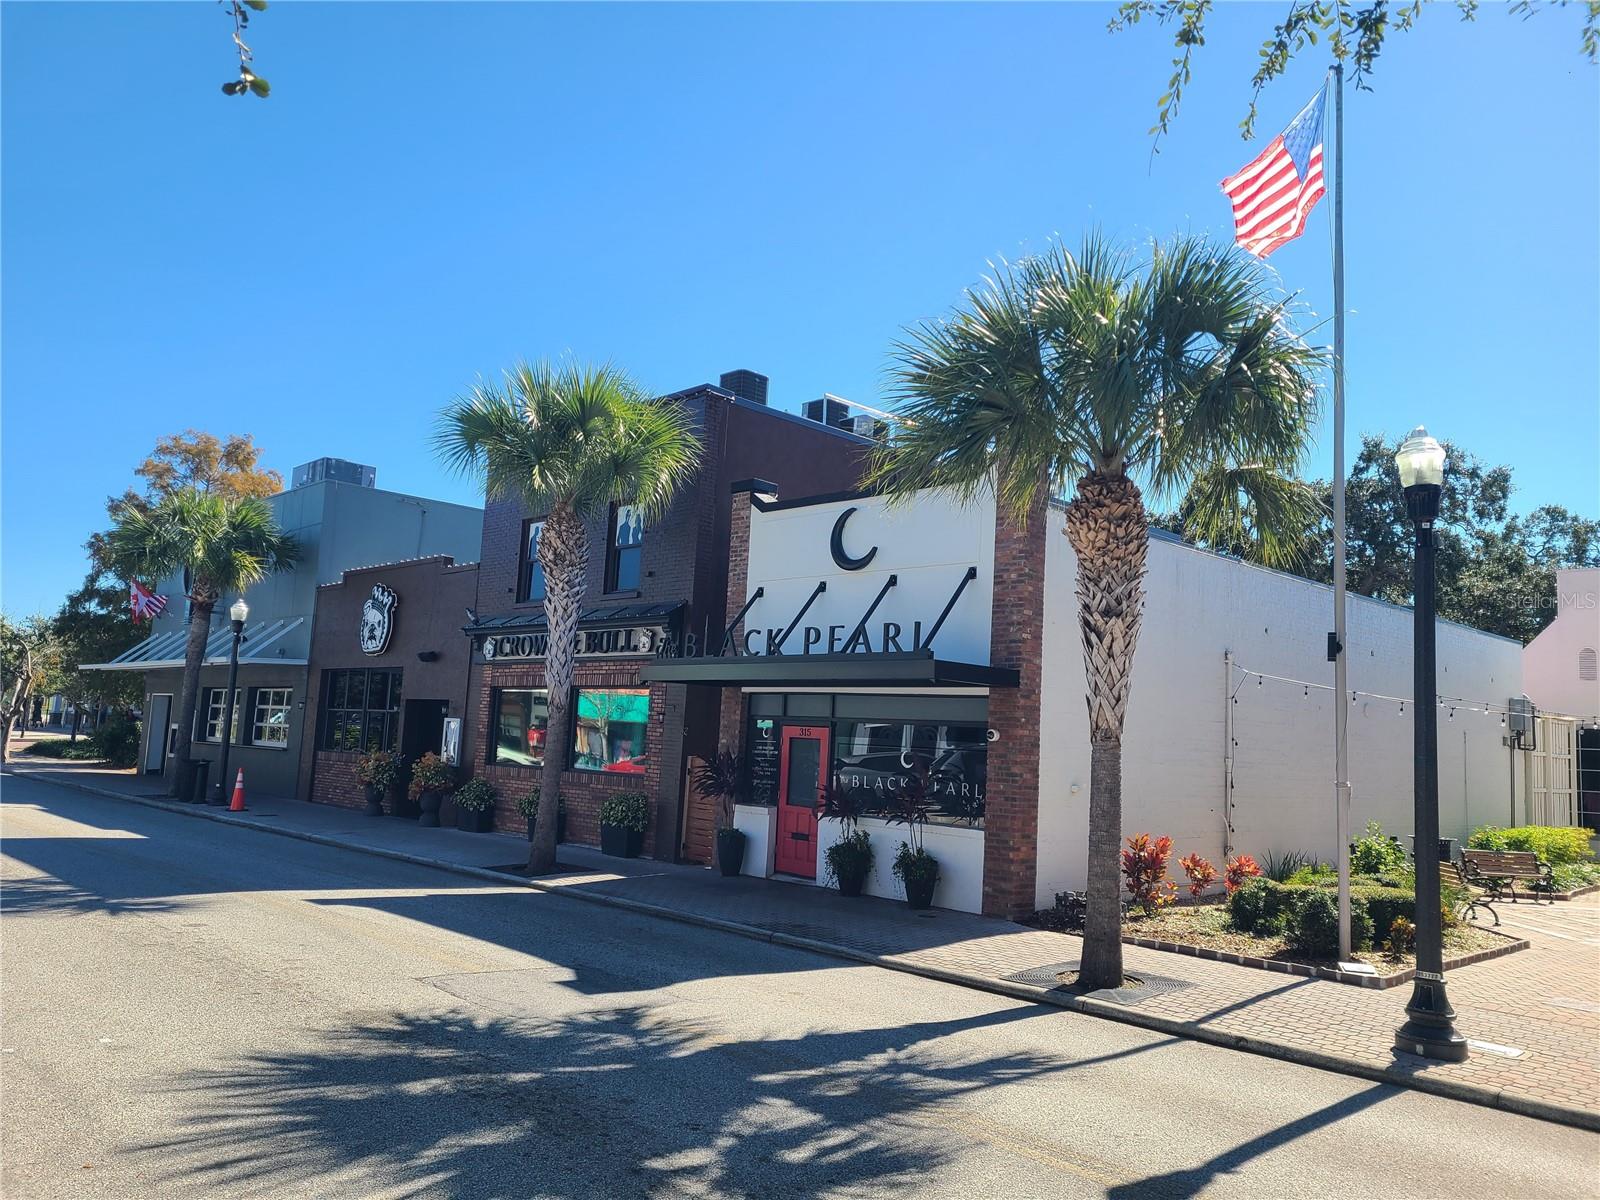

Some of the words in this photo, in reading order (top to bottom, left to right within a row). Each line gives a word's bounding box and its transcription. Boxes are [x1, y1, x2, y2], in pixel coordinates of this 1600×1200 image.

[496, 634, 549, 657] CROW
[583, 629, 639, 654] BULL
[684, 628, 784, 658] BLACK
[803, 621, 931, 655] PEARL
[800, 728, 812, 737] 315
[852, 774, 909, 790] BLACK
